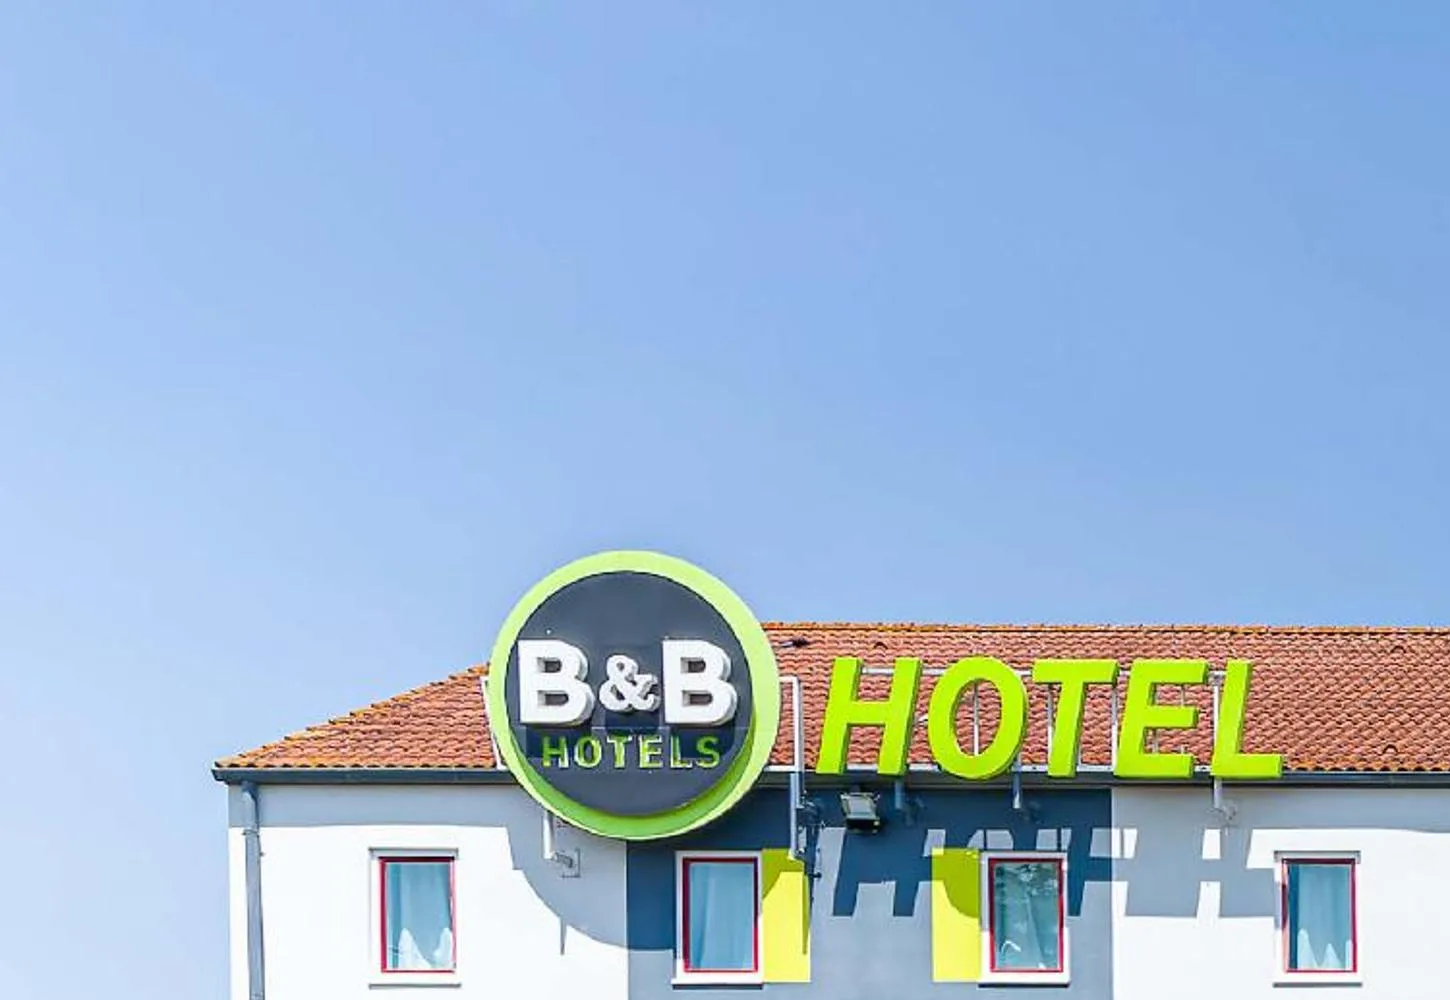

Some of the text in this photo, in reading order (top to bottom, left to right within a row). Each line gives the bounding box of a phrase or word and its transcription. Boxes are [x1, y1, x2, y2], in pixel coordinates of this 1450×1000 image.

[518, 640, 738, 726] B&B
[815, 656, 1282, 779] HOTEL
[541, 733, 720, 768] HOTELS
